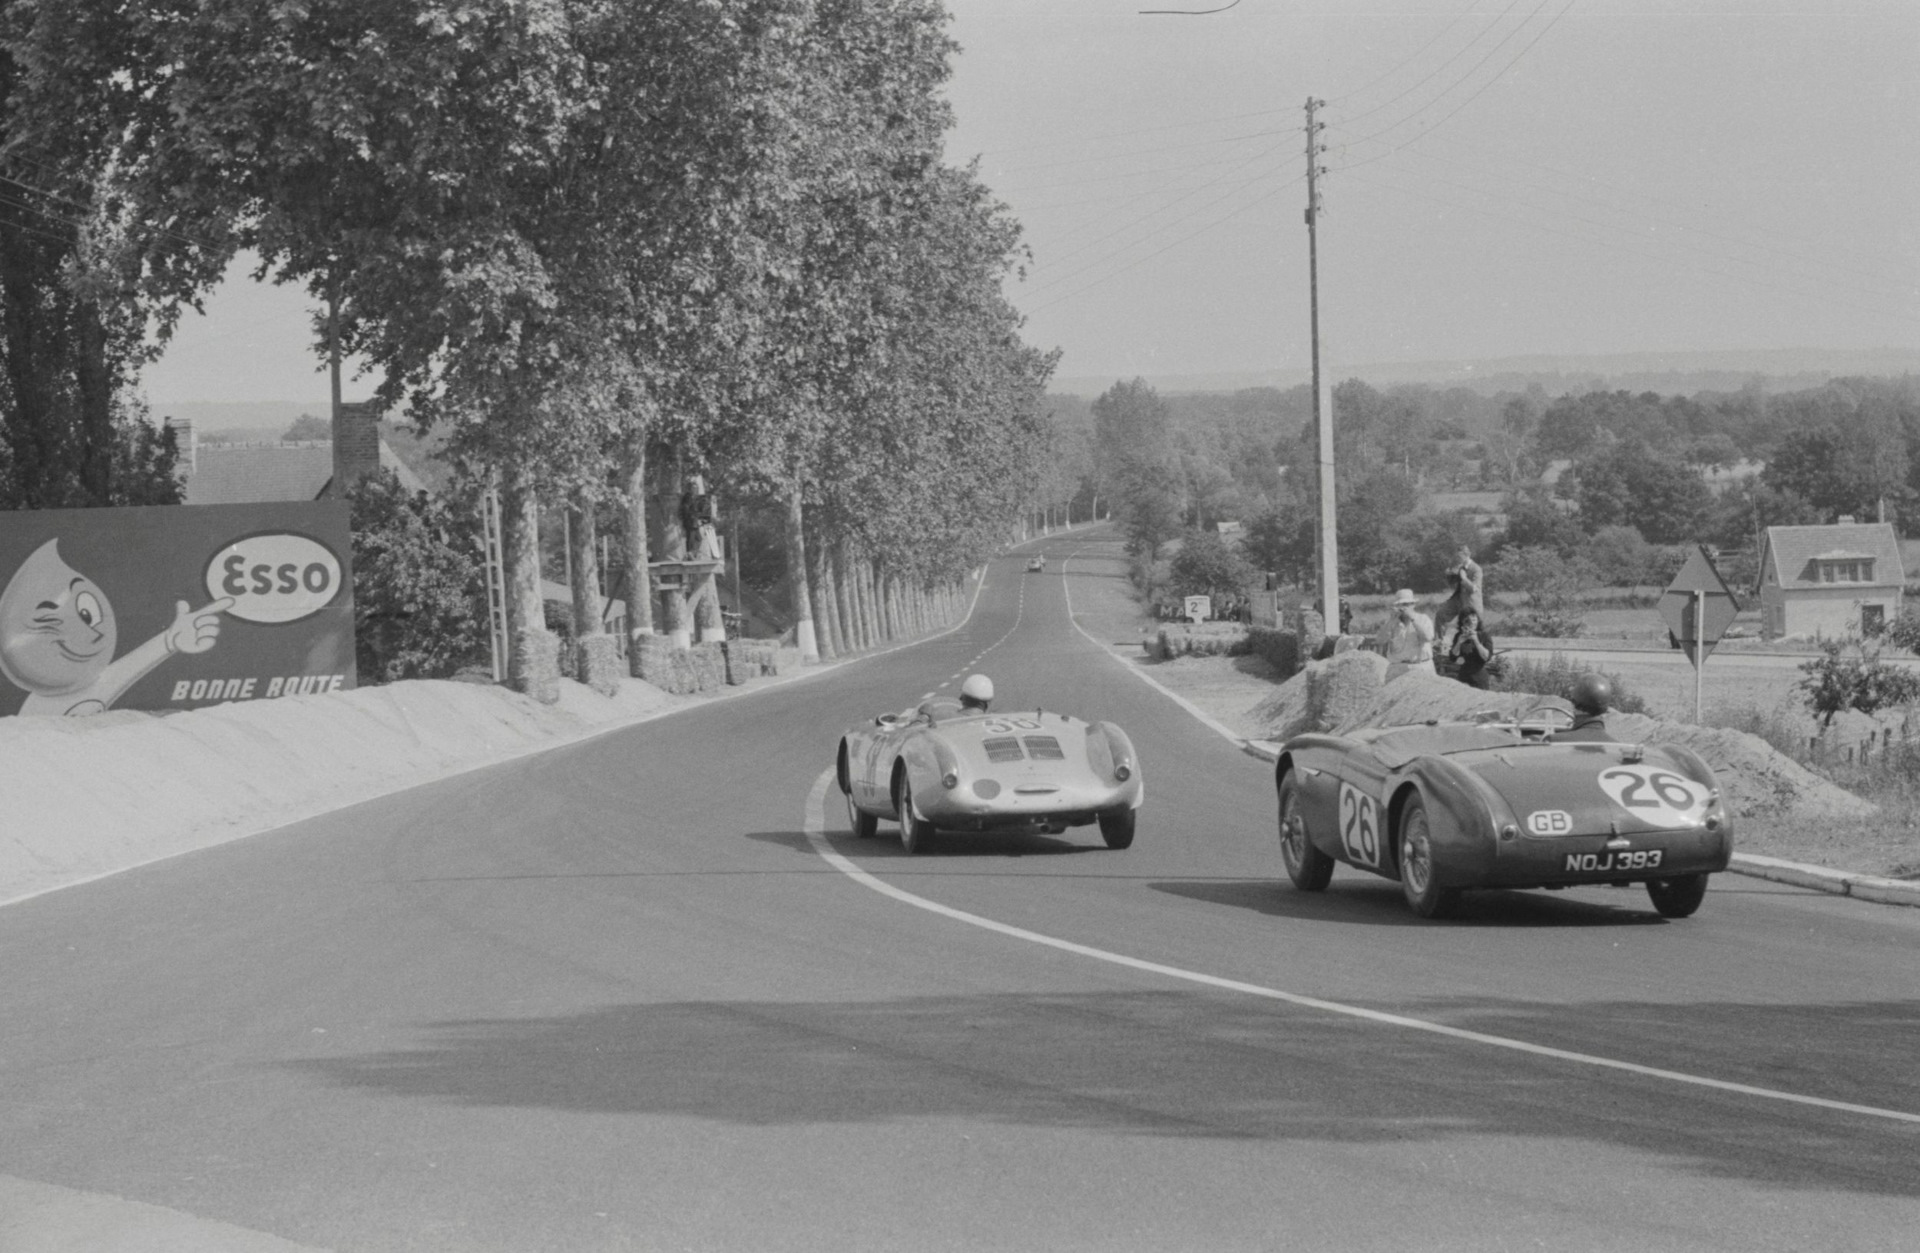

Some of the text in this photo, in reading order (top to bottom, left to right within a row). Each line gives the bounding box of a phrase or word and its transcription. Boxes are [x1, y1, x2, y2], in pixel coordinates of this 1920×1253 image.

[171, 674, 345, 701] BONNE ROUTE
[1604, 771, 1695, 811] 26
[1344, 788, 1377, 864] 26
[1535, 812, 1567, 831] GB
[1566, 850, 1662, 871] NOJ 393
